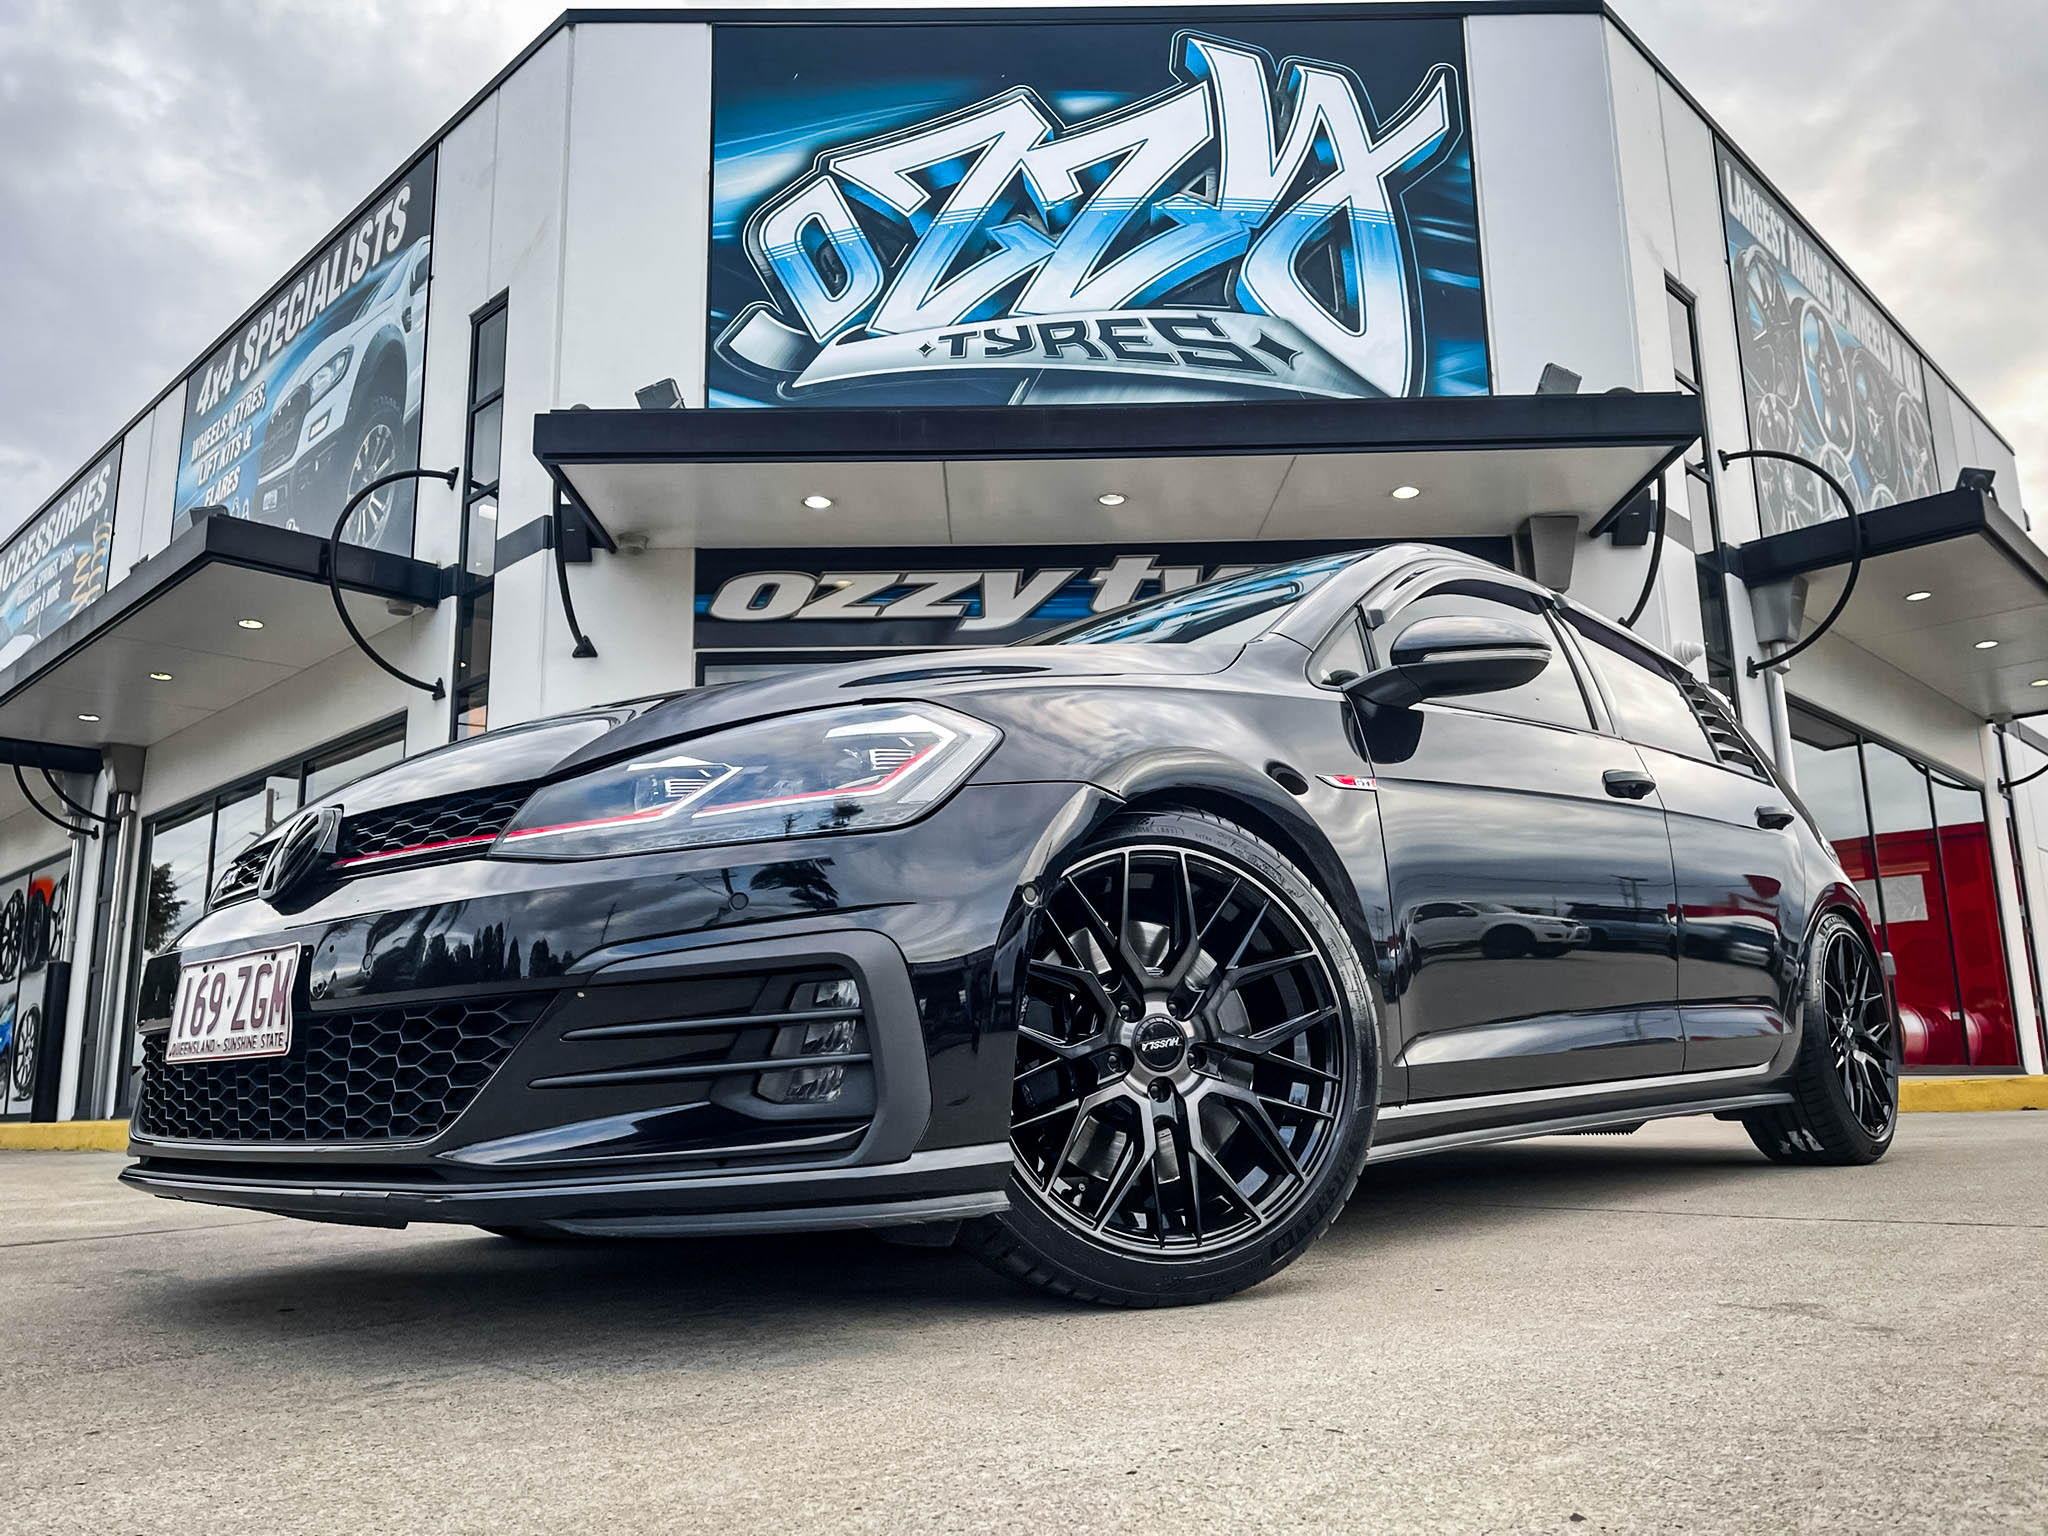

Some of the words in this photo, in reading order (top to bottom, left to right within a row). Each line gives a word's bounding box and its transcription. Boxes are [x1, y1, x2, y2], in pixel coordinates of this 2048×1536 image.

[760, 36, 1452, 398] OZZY
[1724, 160, 1787, 267] LARGEST
[1787, 225, 1832, 311] RANGE
[239, 184, 411, 381] SPECIALISTS
[937, 316, 1276, 376] TYRES
[199, 451, 219, 486] LIFT
[220, 432, 242, 468] KITS
[243, 424, 252, 451] &
[204, 466, 240, 507] FLARES
[707, 570, 1080, 632] ozzy
[223, 1035, 258, 1052] SUNSHINE
[261, 1031, 284, 1049] STATE
